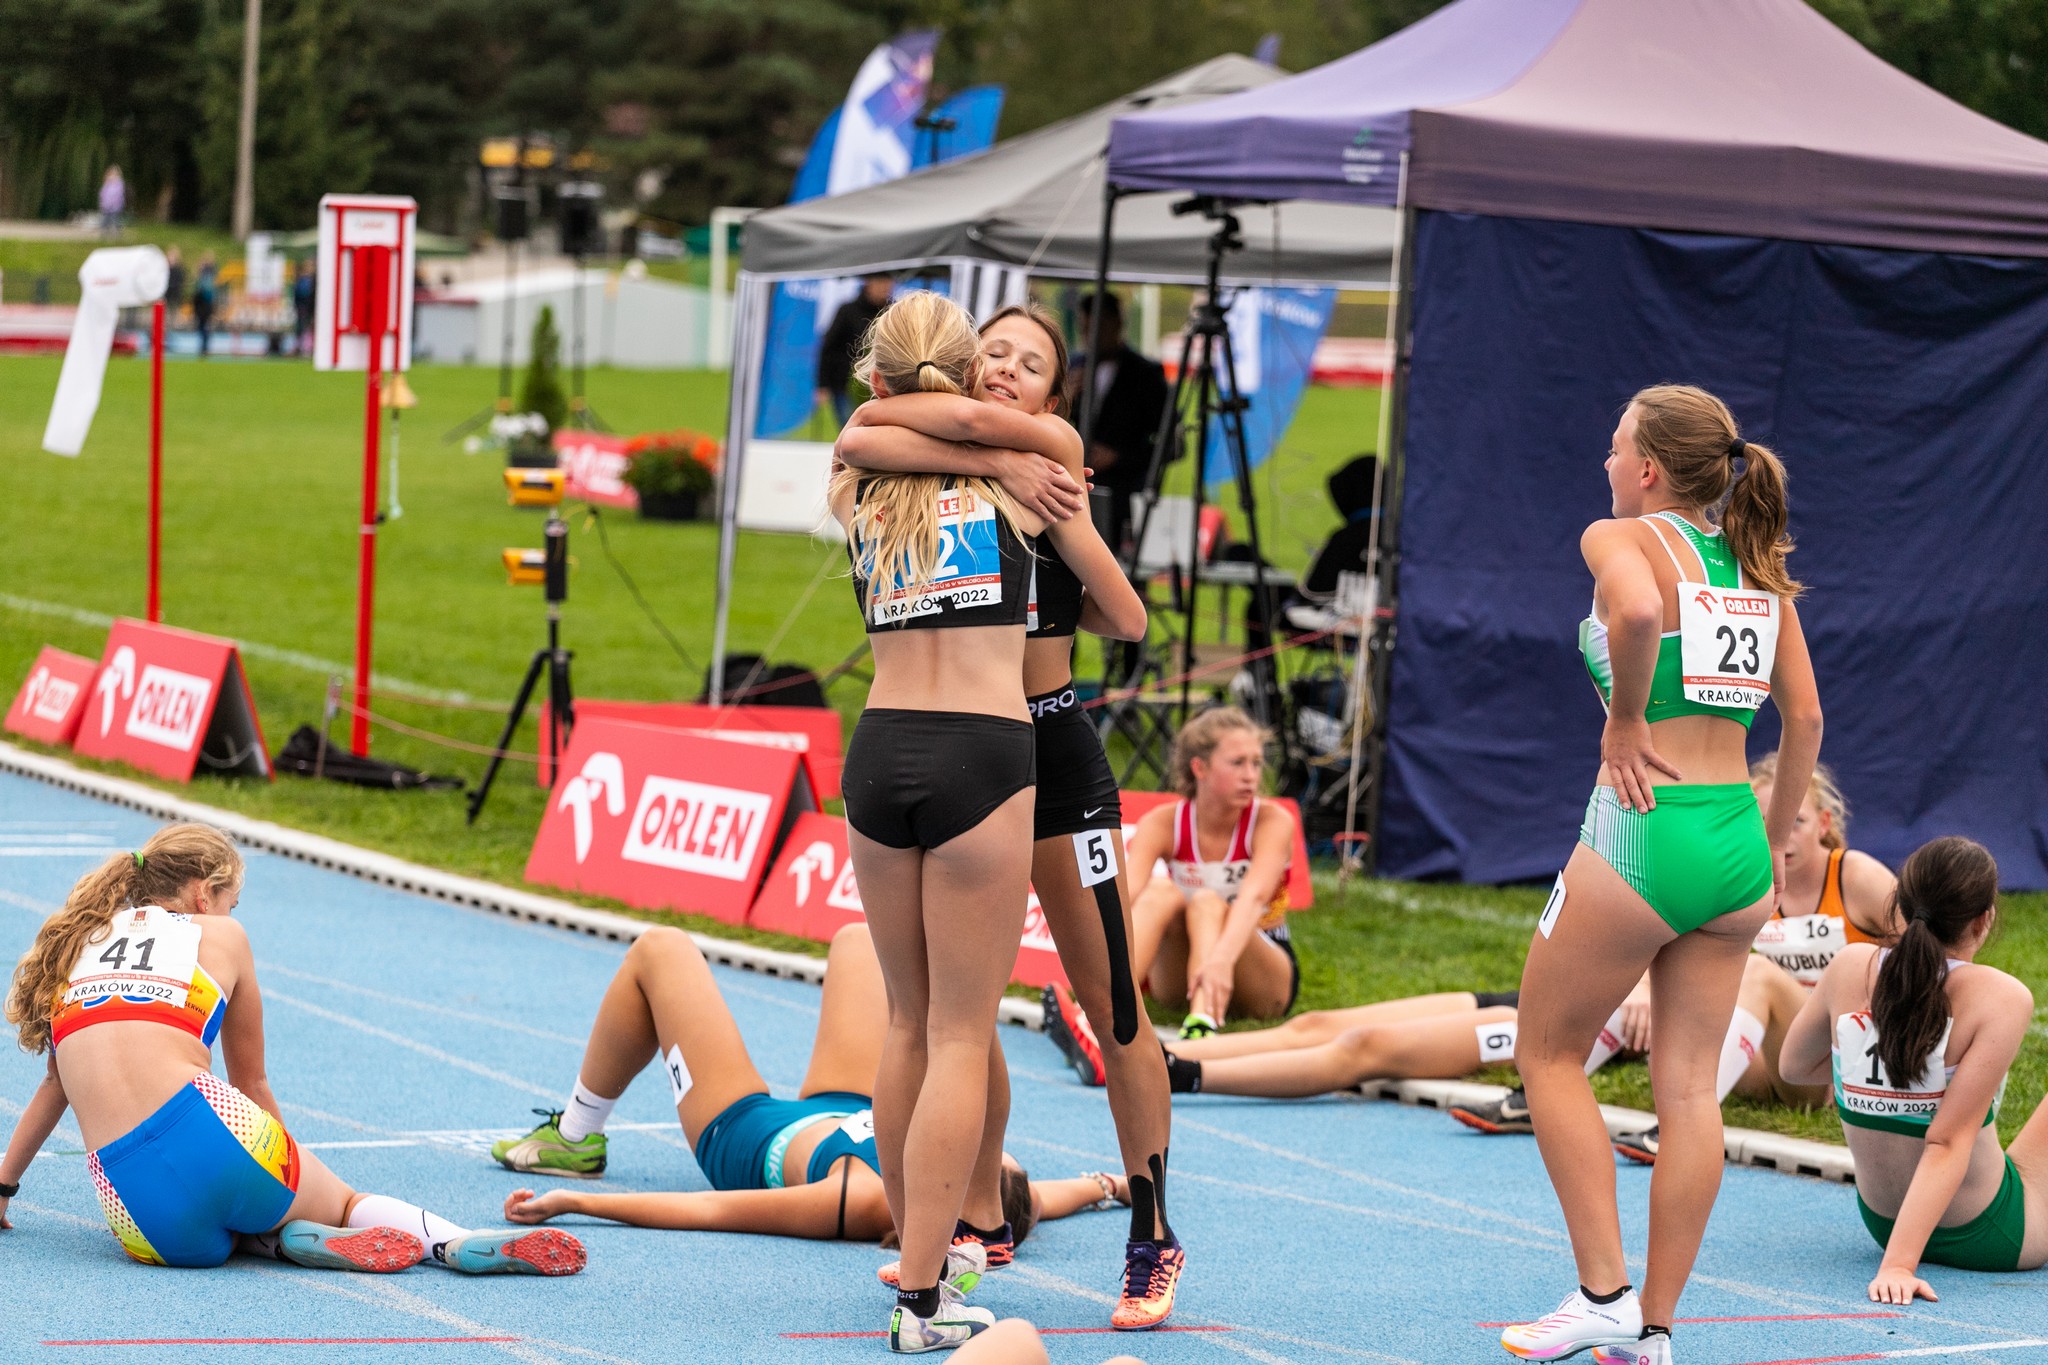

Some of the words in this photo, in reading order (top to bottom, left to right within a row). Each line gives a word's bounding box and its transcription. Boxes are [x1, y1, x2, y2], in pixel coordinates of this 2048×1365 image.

[952, 589, 989, 605] 2022
[1725, 599, 1768, 615] ORLEN
[1716, 625, 1760, 675] 23
[1698, 688, 1752, 704] KRAKÓW
[138, 683, 200, 736] ORLEN
[641, 795, 755, 862] ORLEN
[1087, 835, 1108, 875] 5
[1543, 888, 1560, 922] 1
[1806, 919, 1829, 939] 16
[99, 937, 155, 972] 41
[1766, 952, 1834, 972] KUBIA
[73, 980, 134, 998] KRAKÓW
[138, 984, 173, 1000] 2022
[1486, 1034, 1512, 1050] 6
[670, 1063, 682, 1092] 4
[1847, 1096, 1899, 1112] KRAKÓW
[1903, 1102, 1937, 1112] 2022
